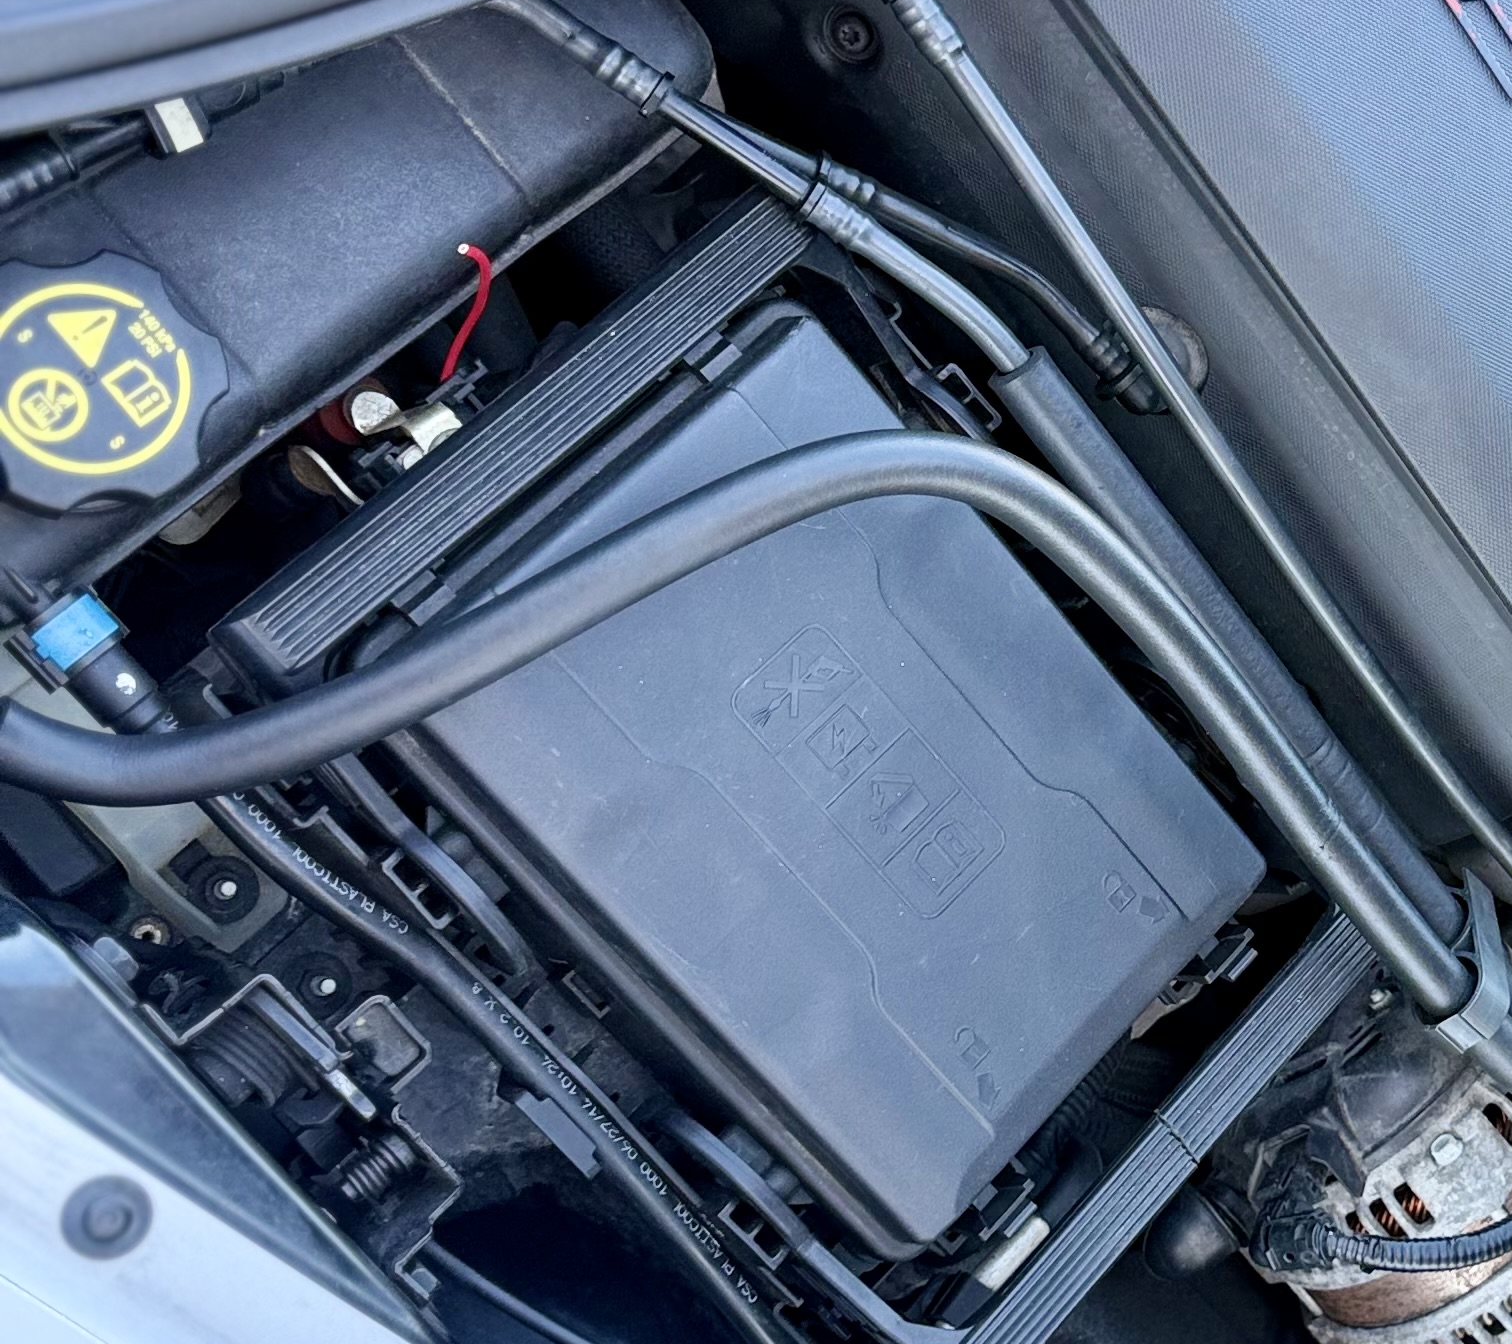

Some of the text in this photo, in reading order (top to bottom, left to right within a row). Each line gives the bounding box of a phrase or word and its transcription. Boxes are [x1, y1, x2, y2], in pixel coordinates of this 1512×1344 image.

[139, 309, 161, 332] 140
[128, 321, 163, 358] 20 PSI
[248, 804, 409, 934] CSA PLASTICOOL 1000
[582, 1097, 638, 1161] 06/27/14
[639, 1161, 668, 1196] 1000
[736, 1274, 758, 1304] CSA
